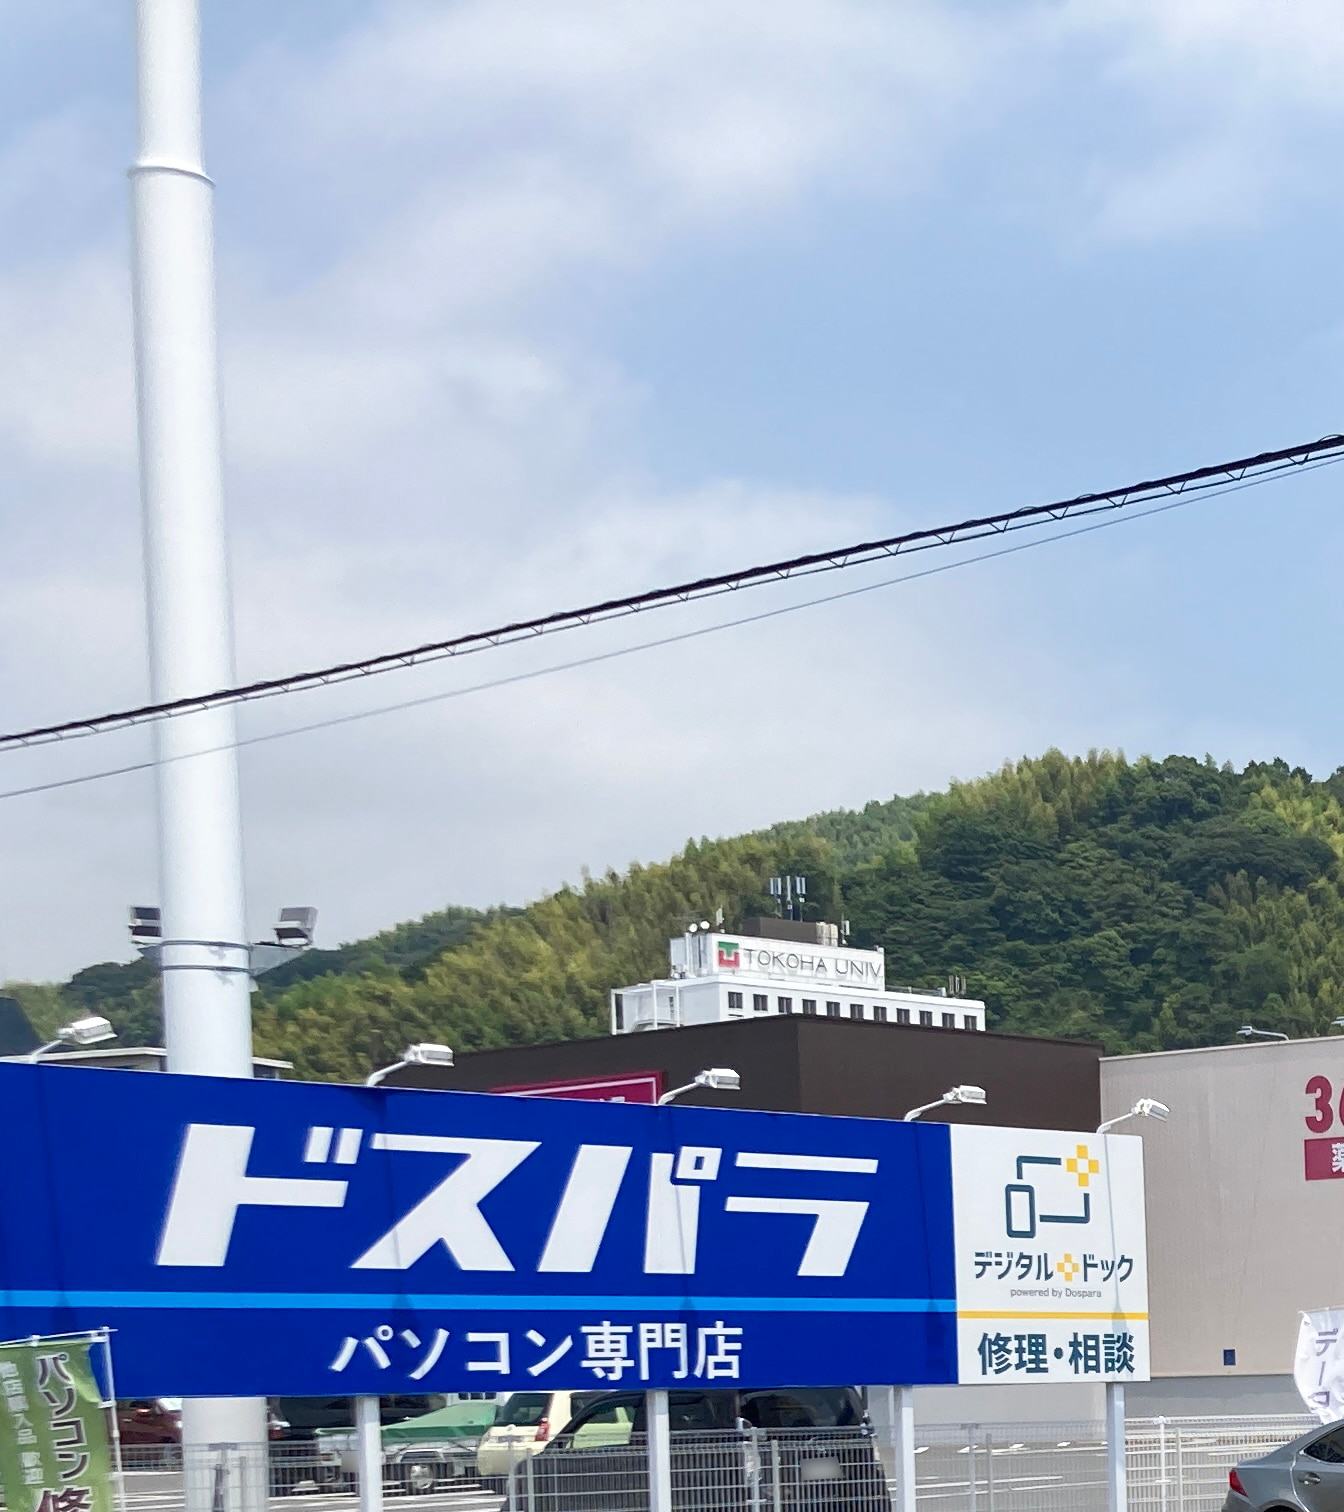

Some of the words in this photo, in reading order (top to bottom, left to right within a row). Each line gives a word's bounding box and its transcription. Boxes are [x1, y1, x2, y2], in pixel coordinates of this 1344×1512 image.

[743, 948, 828, 972] TOKOHA
[835, 958, 882, 977] UNIV
[155, 1122, 879, 1277] ドスパラ
[974, 1251, 1054, 1281] デジタル
[1083, 1253, 1134, 1283] ドック
[1010, 1287, 1050, 1297] powered
[1052, 1288, 1063, 1298] by
[1065, 1288, 1102, 1298] Dospara
[331, 1321, 744, 1380] パソコン専門店
